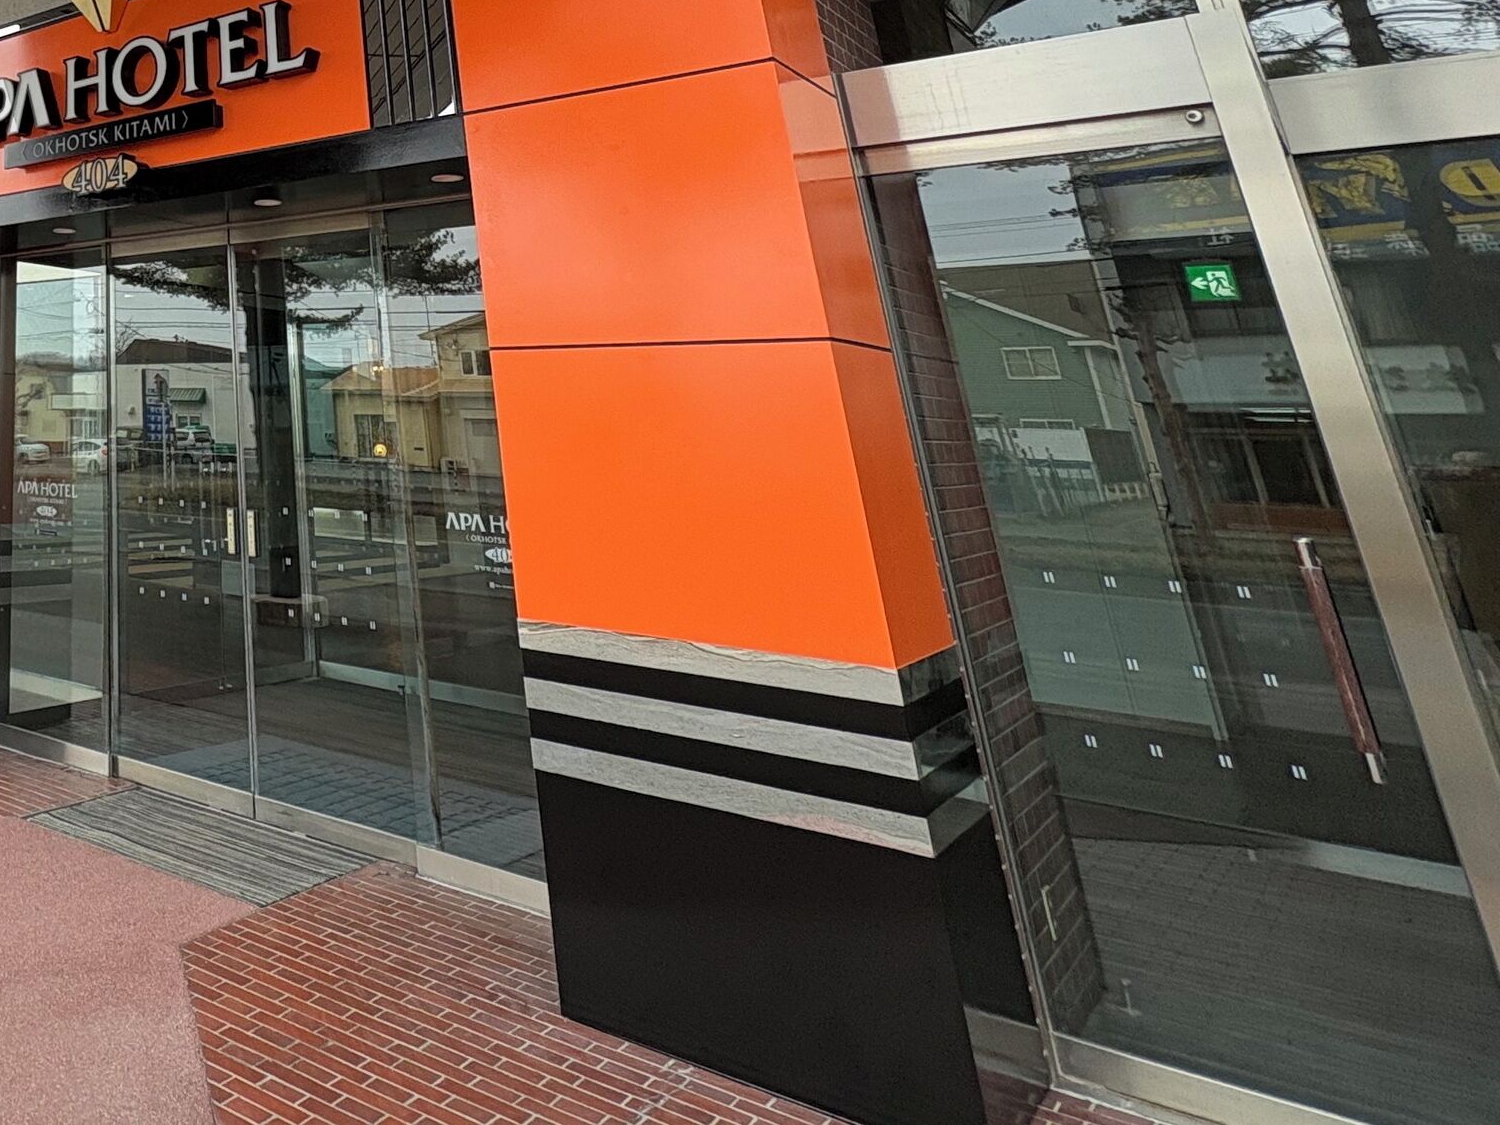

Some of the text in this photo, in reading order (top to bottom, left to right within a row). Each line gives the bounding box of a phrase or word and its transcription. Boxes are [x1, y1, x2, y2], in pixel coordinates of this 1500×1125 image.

[63, 0, 318, 124] HOTEL
[71, 153, 129, 195] 404
[17, 480, 78, 498] APA HOTEL
[445, 511, 486, 533] APA
